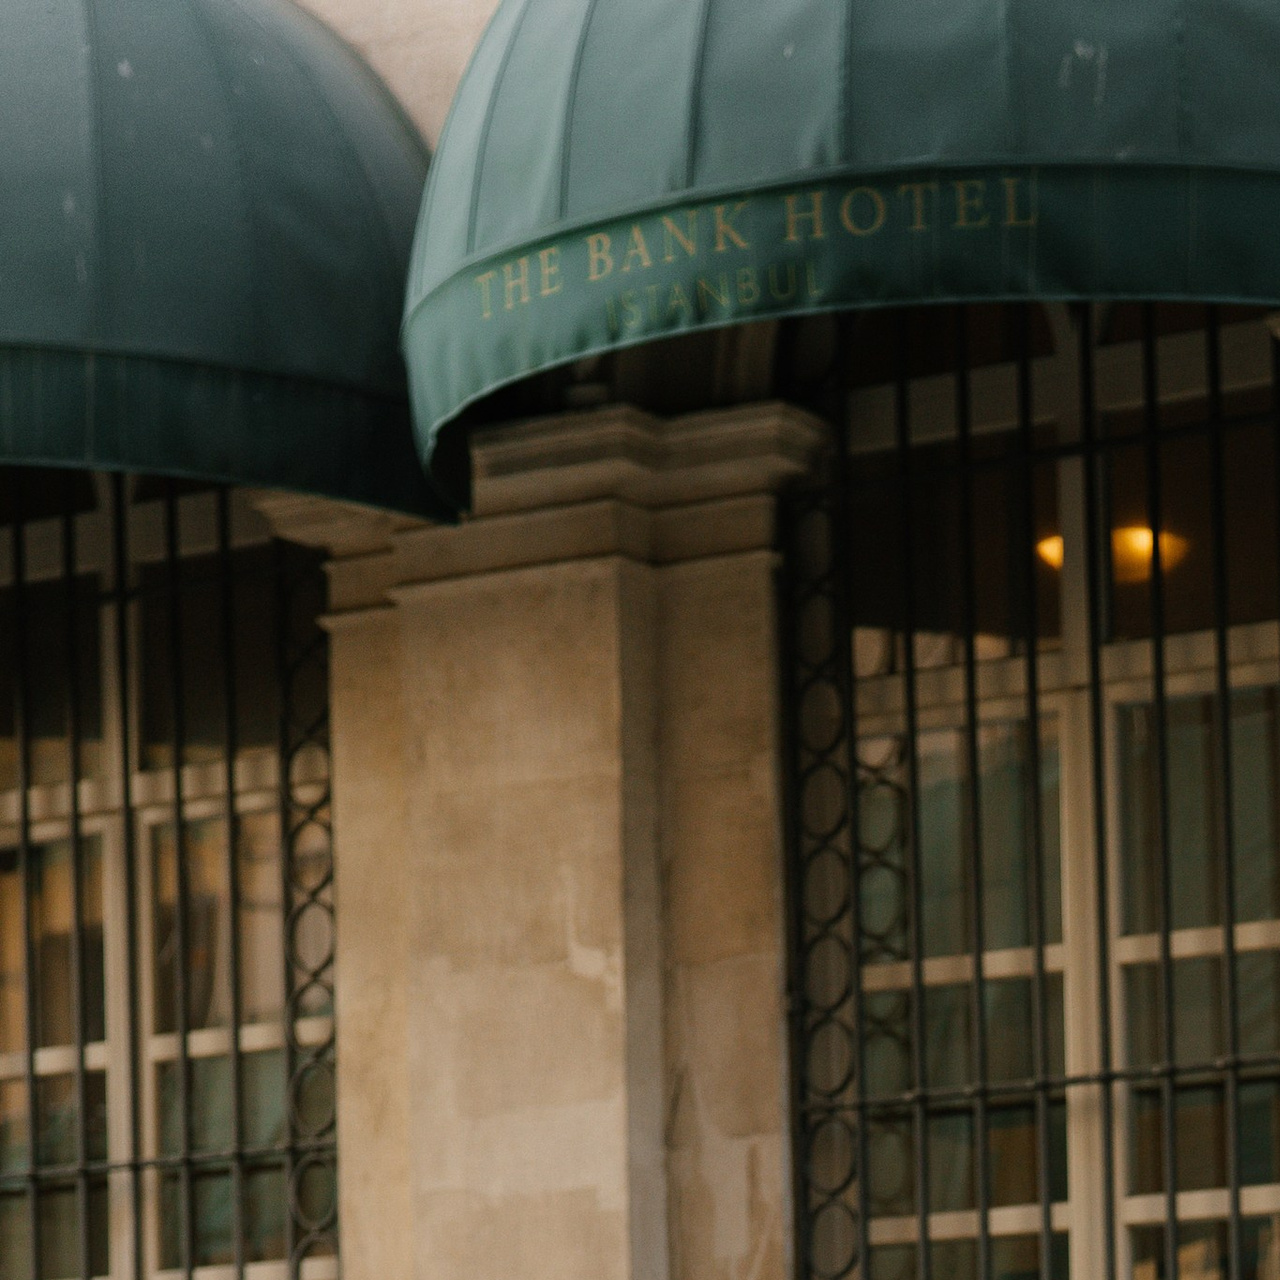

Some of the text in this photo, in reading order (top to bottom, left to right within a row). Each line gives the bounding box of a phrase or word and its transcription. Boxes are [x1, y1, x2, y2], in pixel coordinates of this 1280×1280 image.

[475, 177, 1037, 320] THE BANK HOTEL
[605, 261, 823, 331] ISTANBUL
